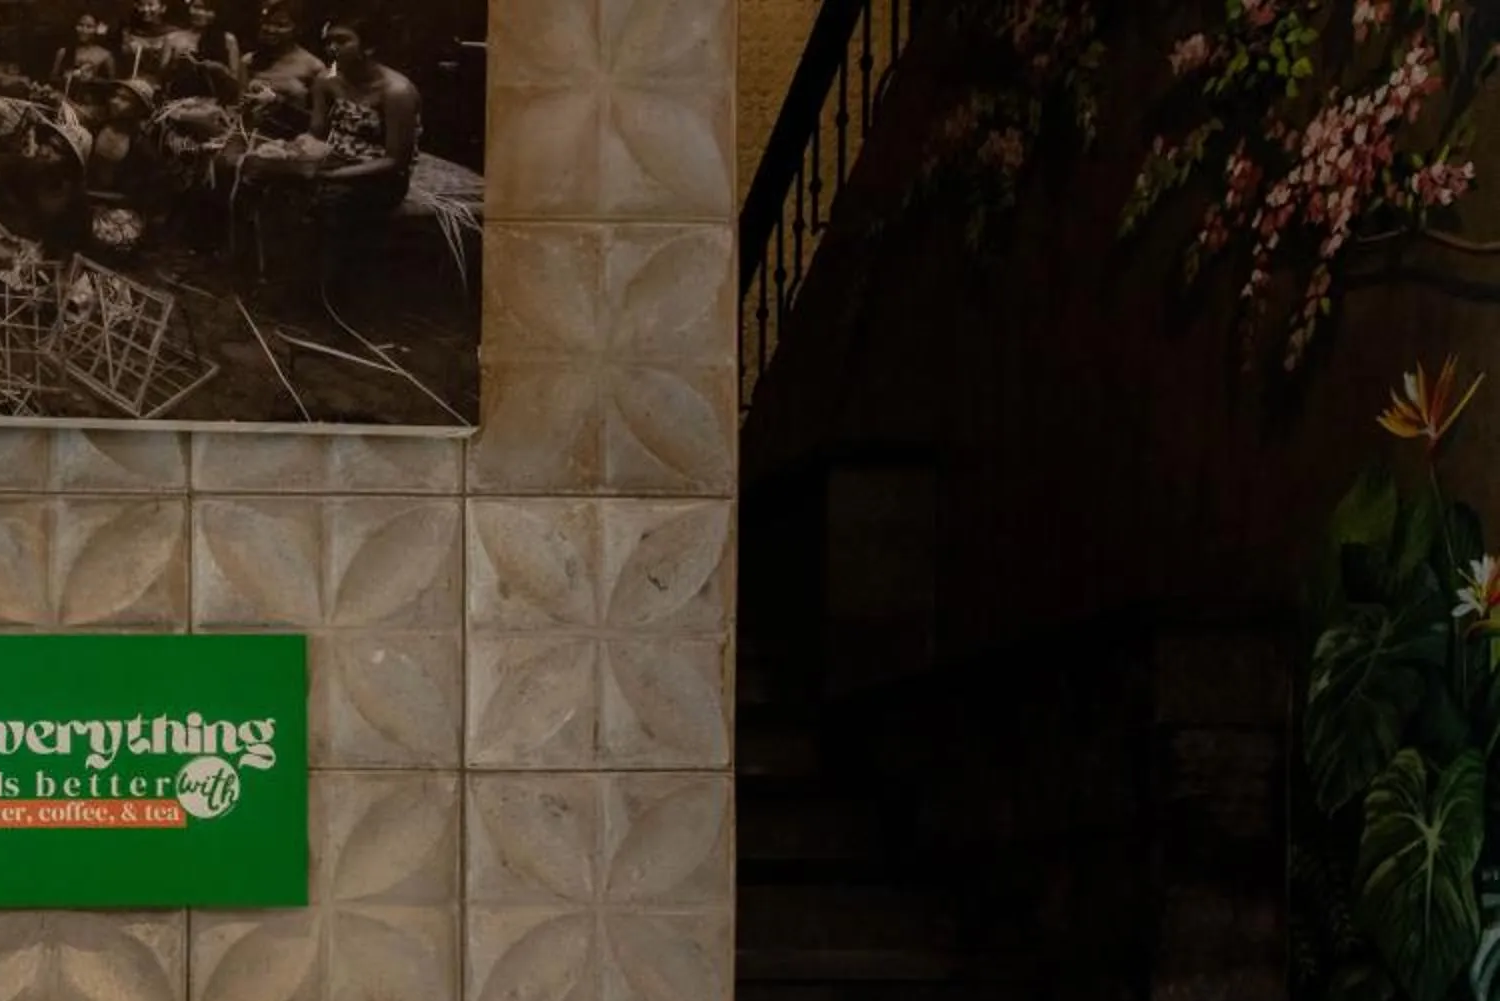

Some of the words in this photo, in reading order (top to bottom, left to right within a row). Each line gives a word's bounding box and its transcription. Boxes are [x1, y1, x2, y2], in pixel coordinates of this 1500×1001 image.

[35, 771, 172, 798] better
[178, 767, 237, 812] with
[38, 801, 115, 823] coffee,
[120, 803, 138, 821] &
[145, 803, 181, 821] tea
